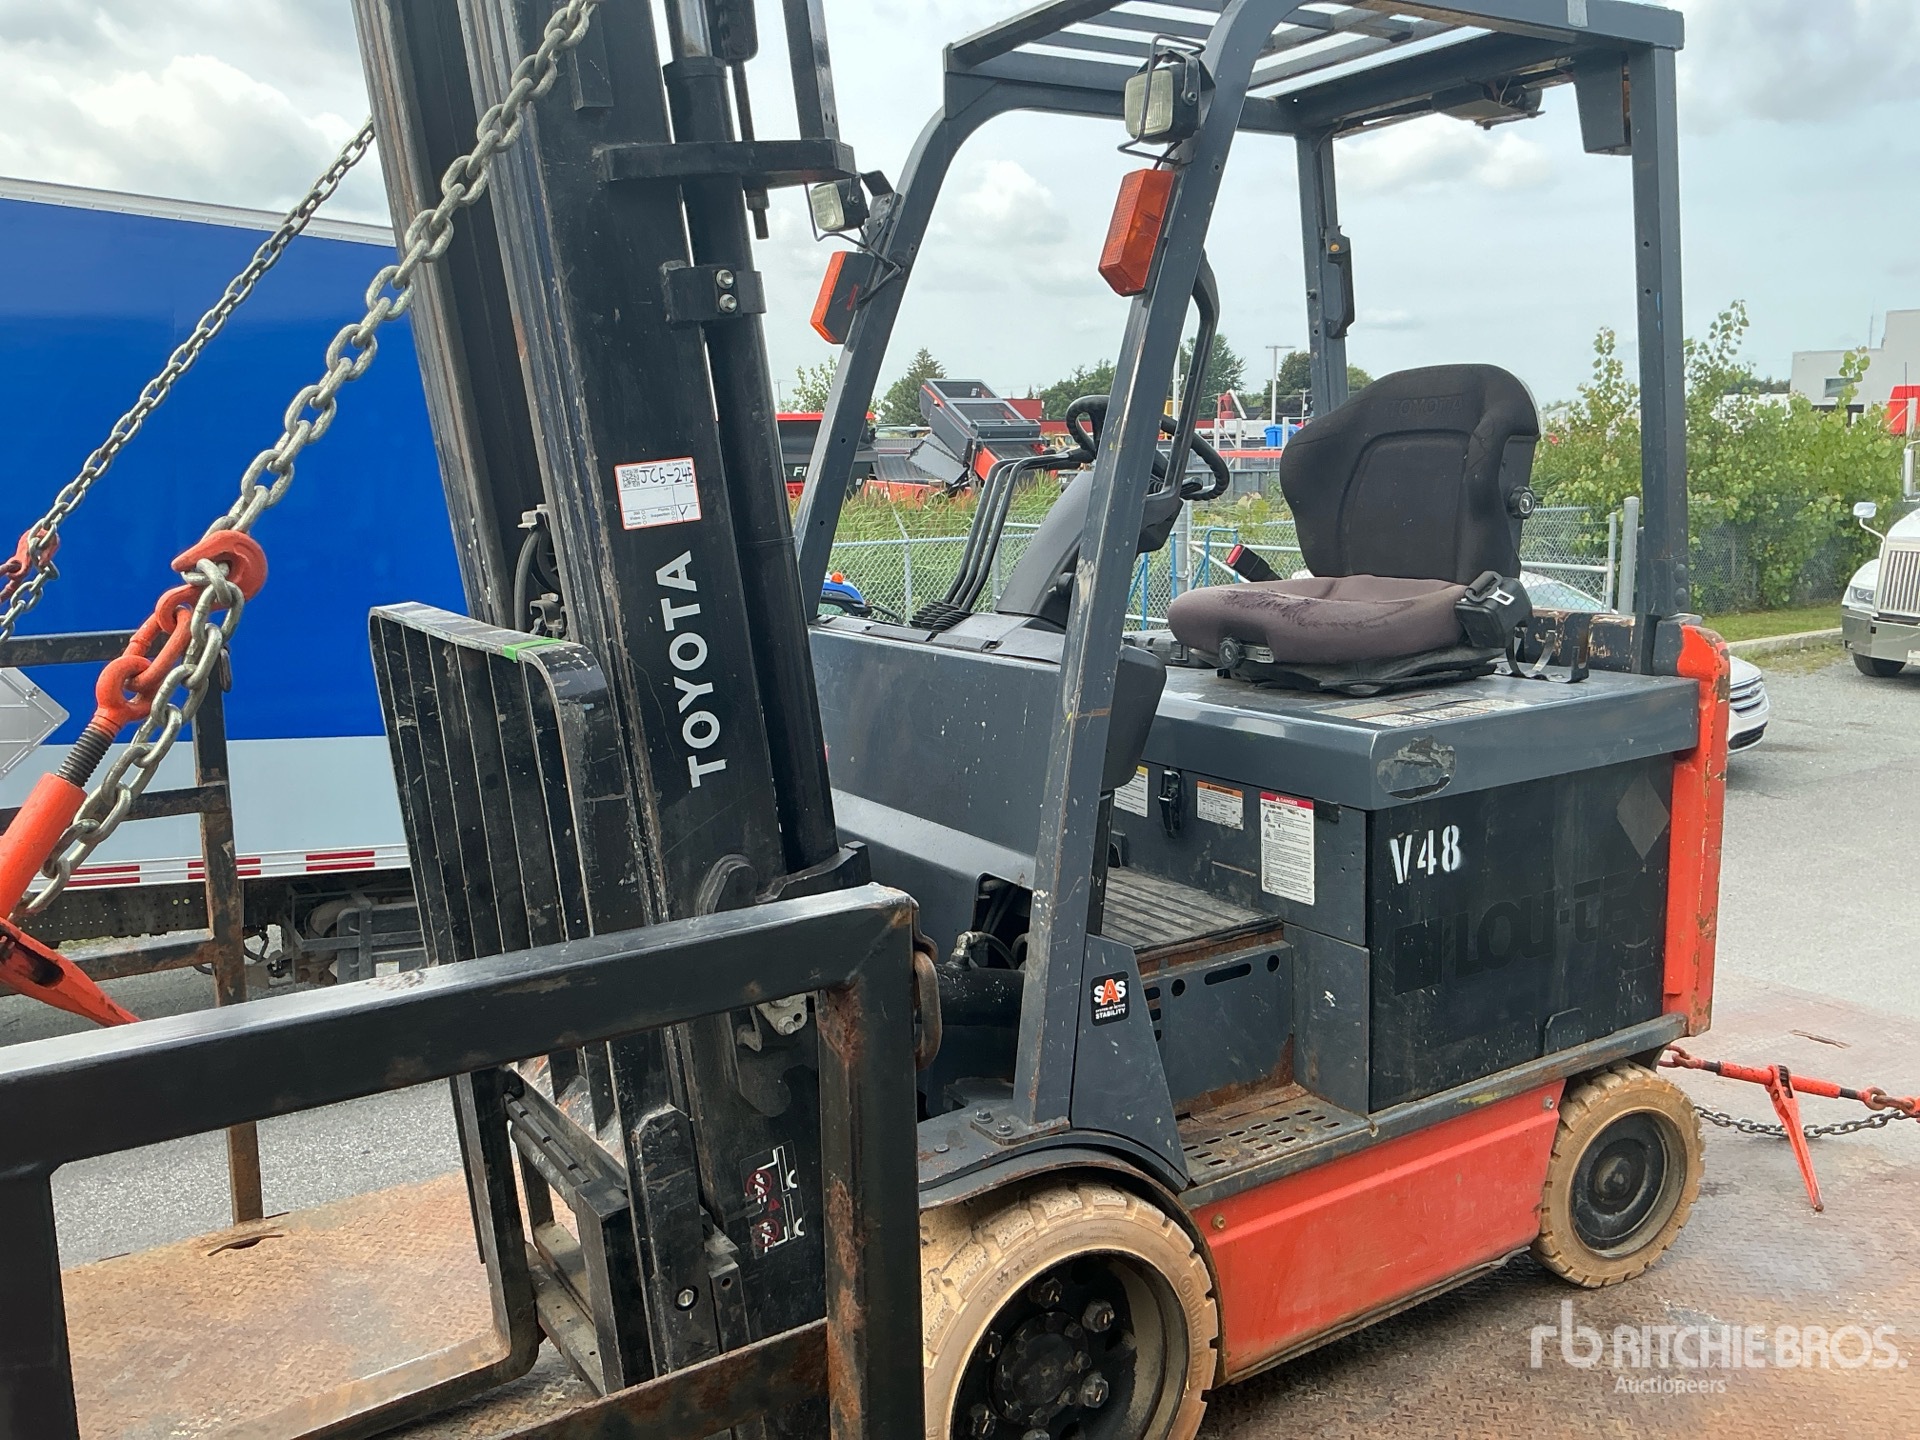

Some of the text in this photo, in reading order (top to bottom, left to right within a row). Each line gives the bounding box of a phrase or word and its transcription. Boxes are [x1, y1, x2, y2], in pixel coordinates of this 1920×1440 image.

[655, 550, 728, 789] TOYOTA
[1094, 979, 1126, 1005] SAS
[1095, 1007, 1126, 1019] STABILITY
